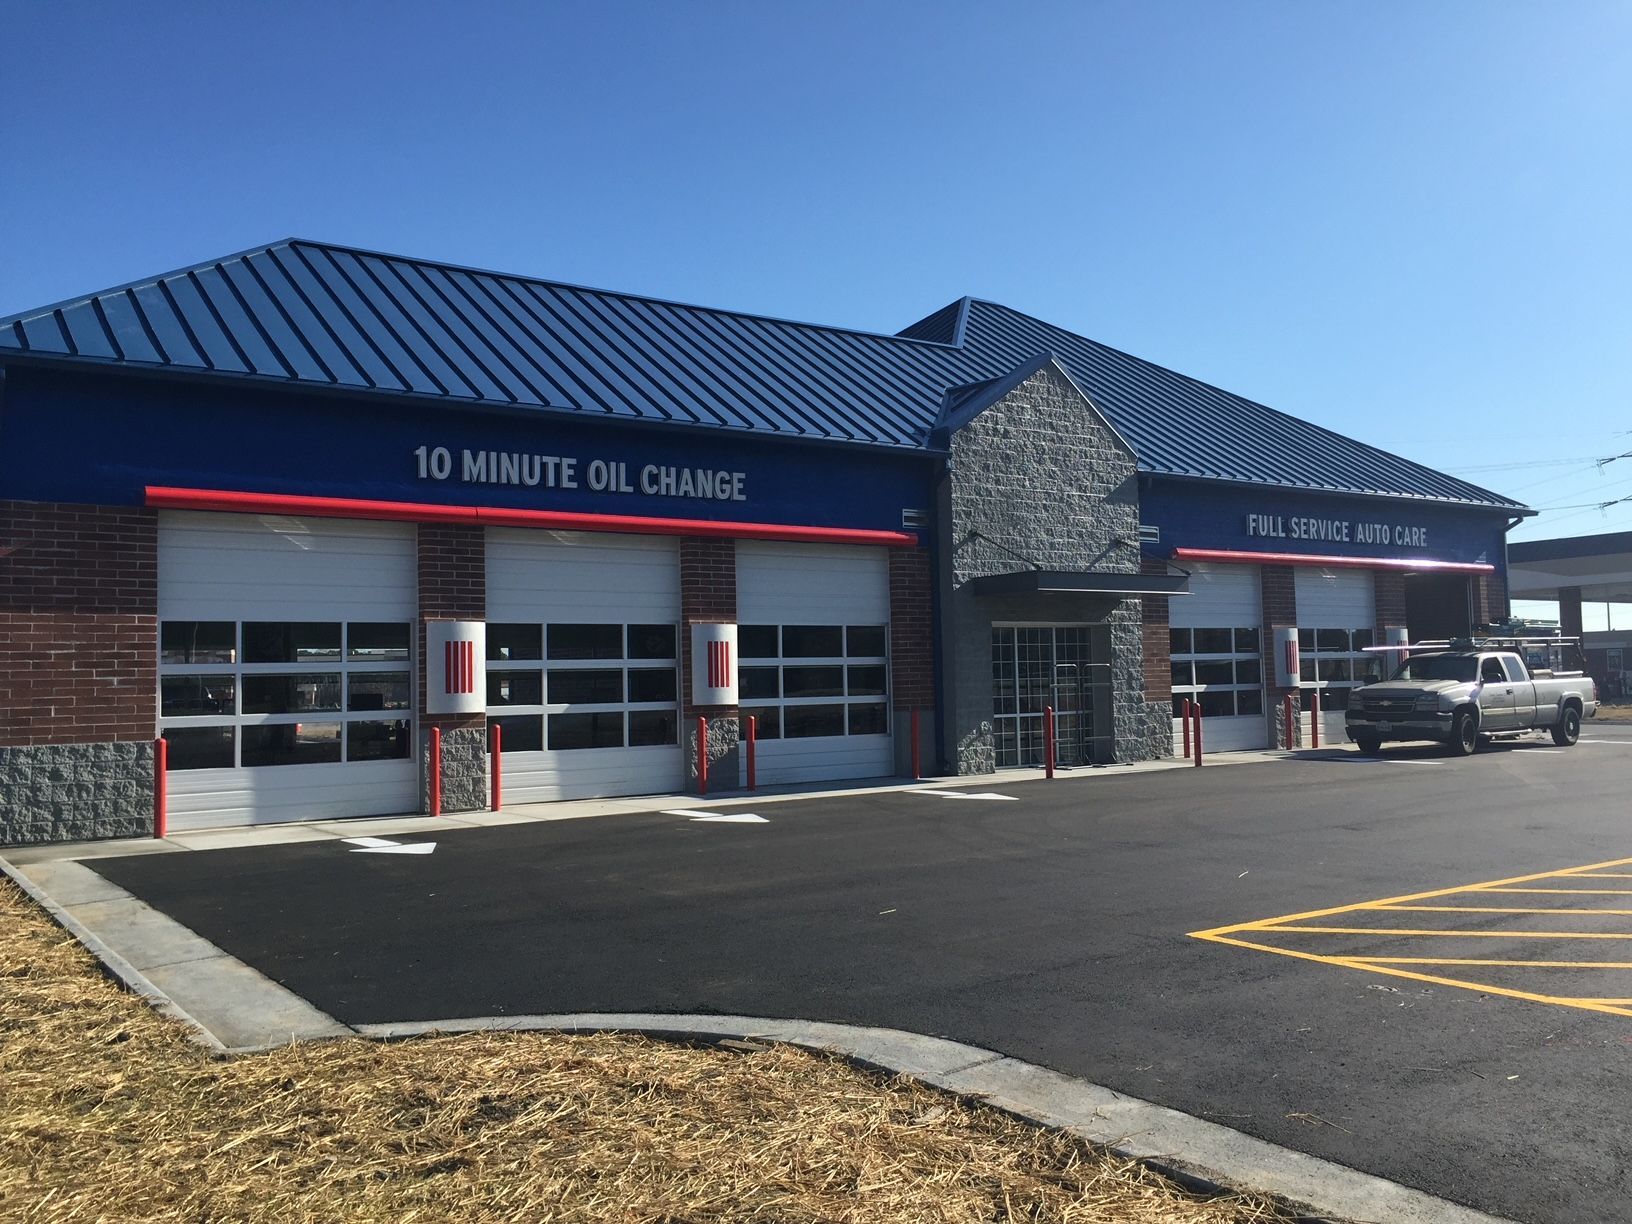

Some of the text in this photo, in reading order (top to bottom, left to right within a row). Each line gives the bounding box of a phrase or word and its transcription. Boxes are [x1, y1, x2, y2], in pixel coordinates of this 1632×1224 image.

[414, 445, 747, 501] 10 MINUTE OIL CHANGE
[1247, 513, 1427, 547] FULL SERVICE AUTO CARE
